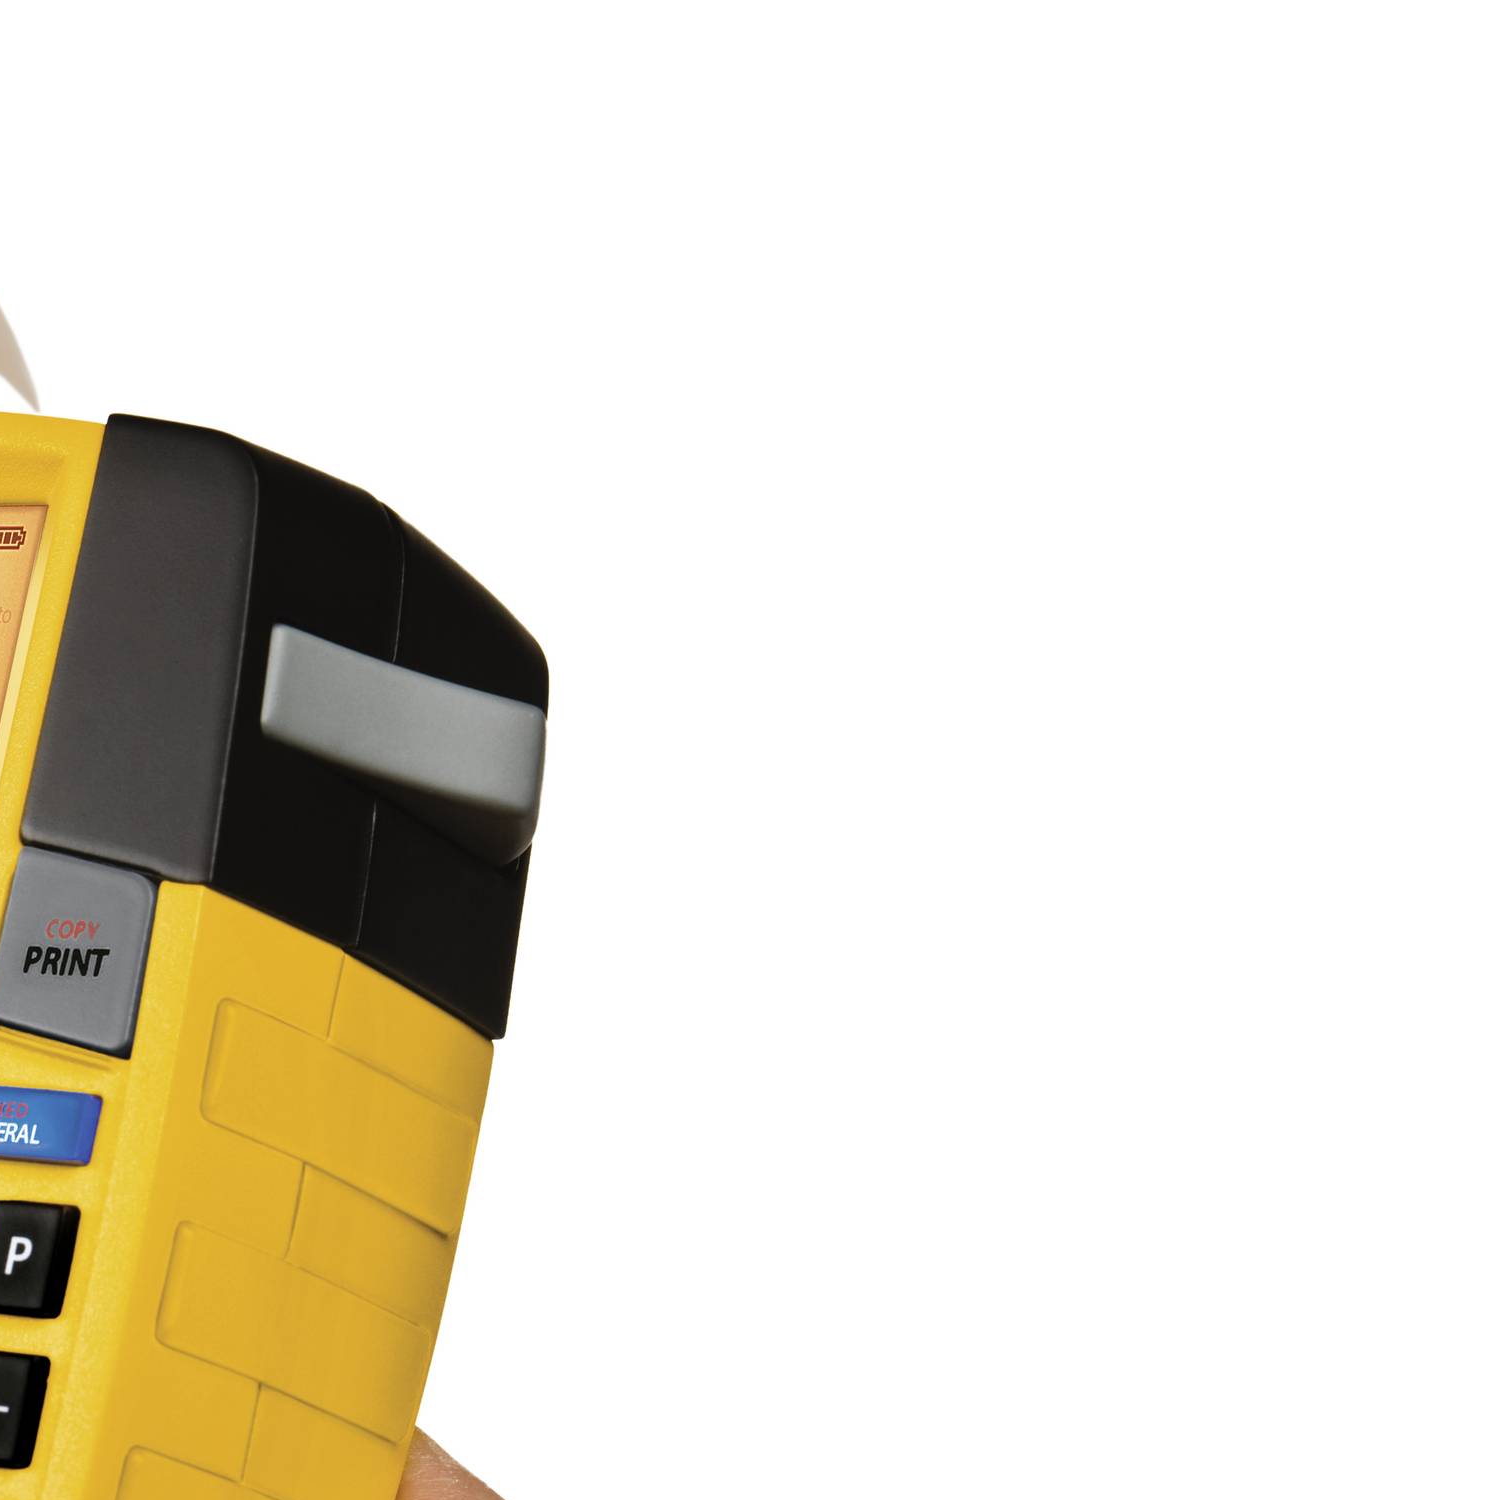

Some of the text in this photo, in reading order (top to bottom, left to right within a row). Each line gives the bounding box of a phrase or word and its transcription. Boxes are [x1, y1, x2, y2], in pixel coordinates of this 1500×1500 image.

[45, 918, 100, 941] COPY
[23, 945, 110, 978] PRINT
[4, 1236, 33, 1276] P
